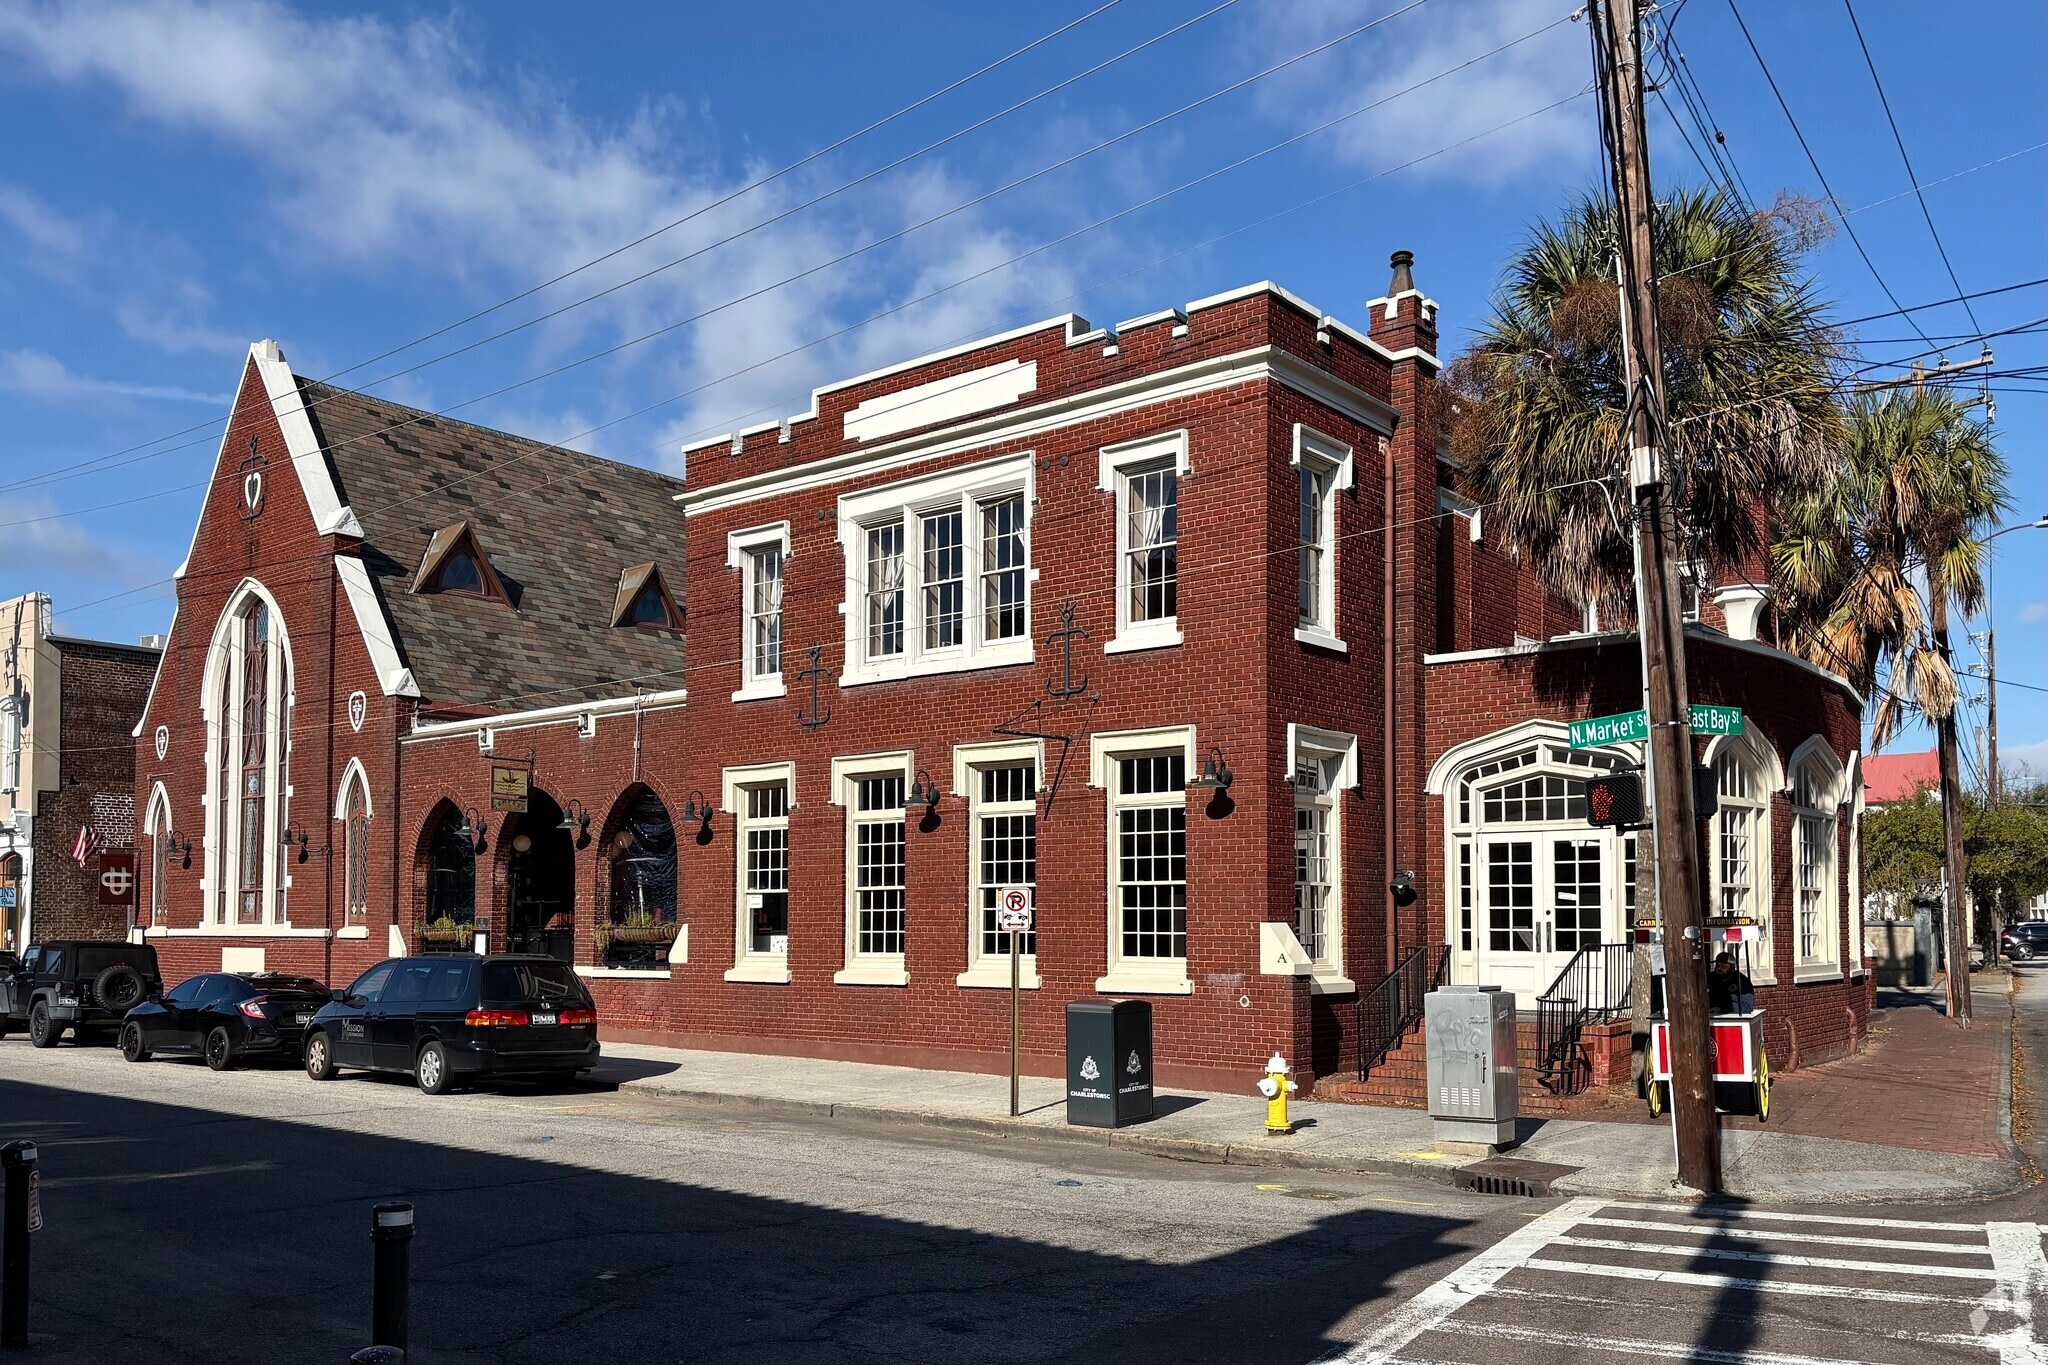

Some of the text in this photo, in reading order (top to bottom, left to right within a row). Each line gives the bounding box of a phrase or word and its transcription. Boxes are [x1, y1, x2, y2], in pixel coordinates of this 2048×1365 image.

[1711, 709, 1730, 735] Bay
[1731, 710, 1740, 724] St
[1706, 918, 1750, 926] INFORMATION
[1277, 953, 1287, 963] A
